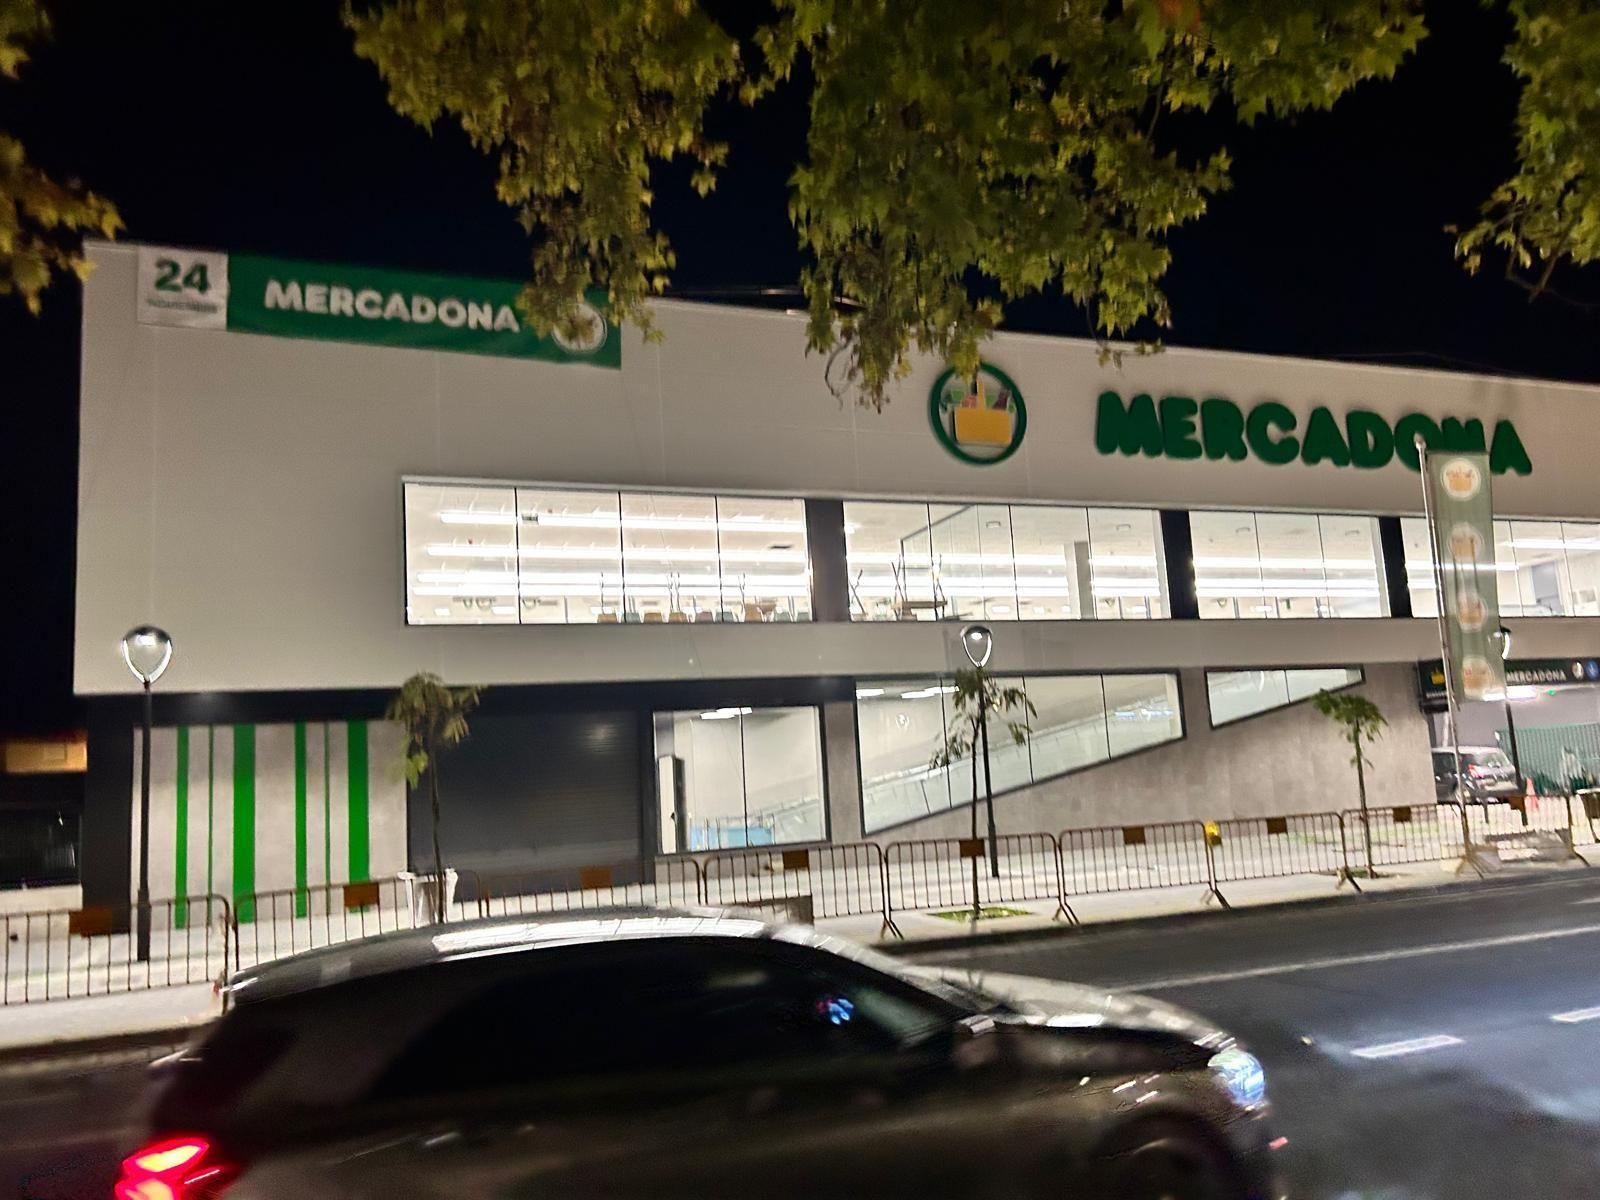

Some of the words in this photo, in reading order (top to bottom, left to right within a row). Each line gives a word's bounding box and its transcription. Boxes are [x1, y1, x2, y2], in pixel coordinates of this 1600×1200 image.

[154, 257, 210, 294] 24
[263, 278, 521, 333] MERCADONA
[1095, 391, 1534, 476] MERCADONA
[1506, 669, 1567, 683] MERCADONA
